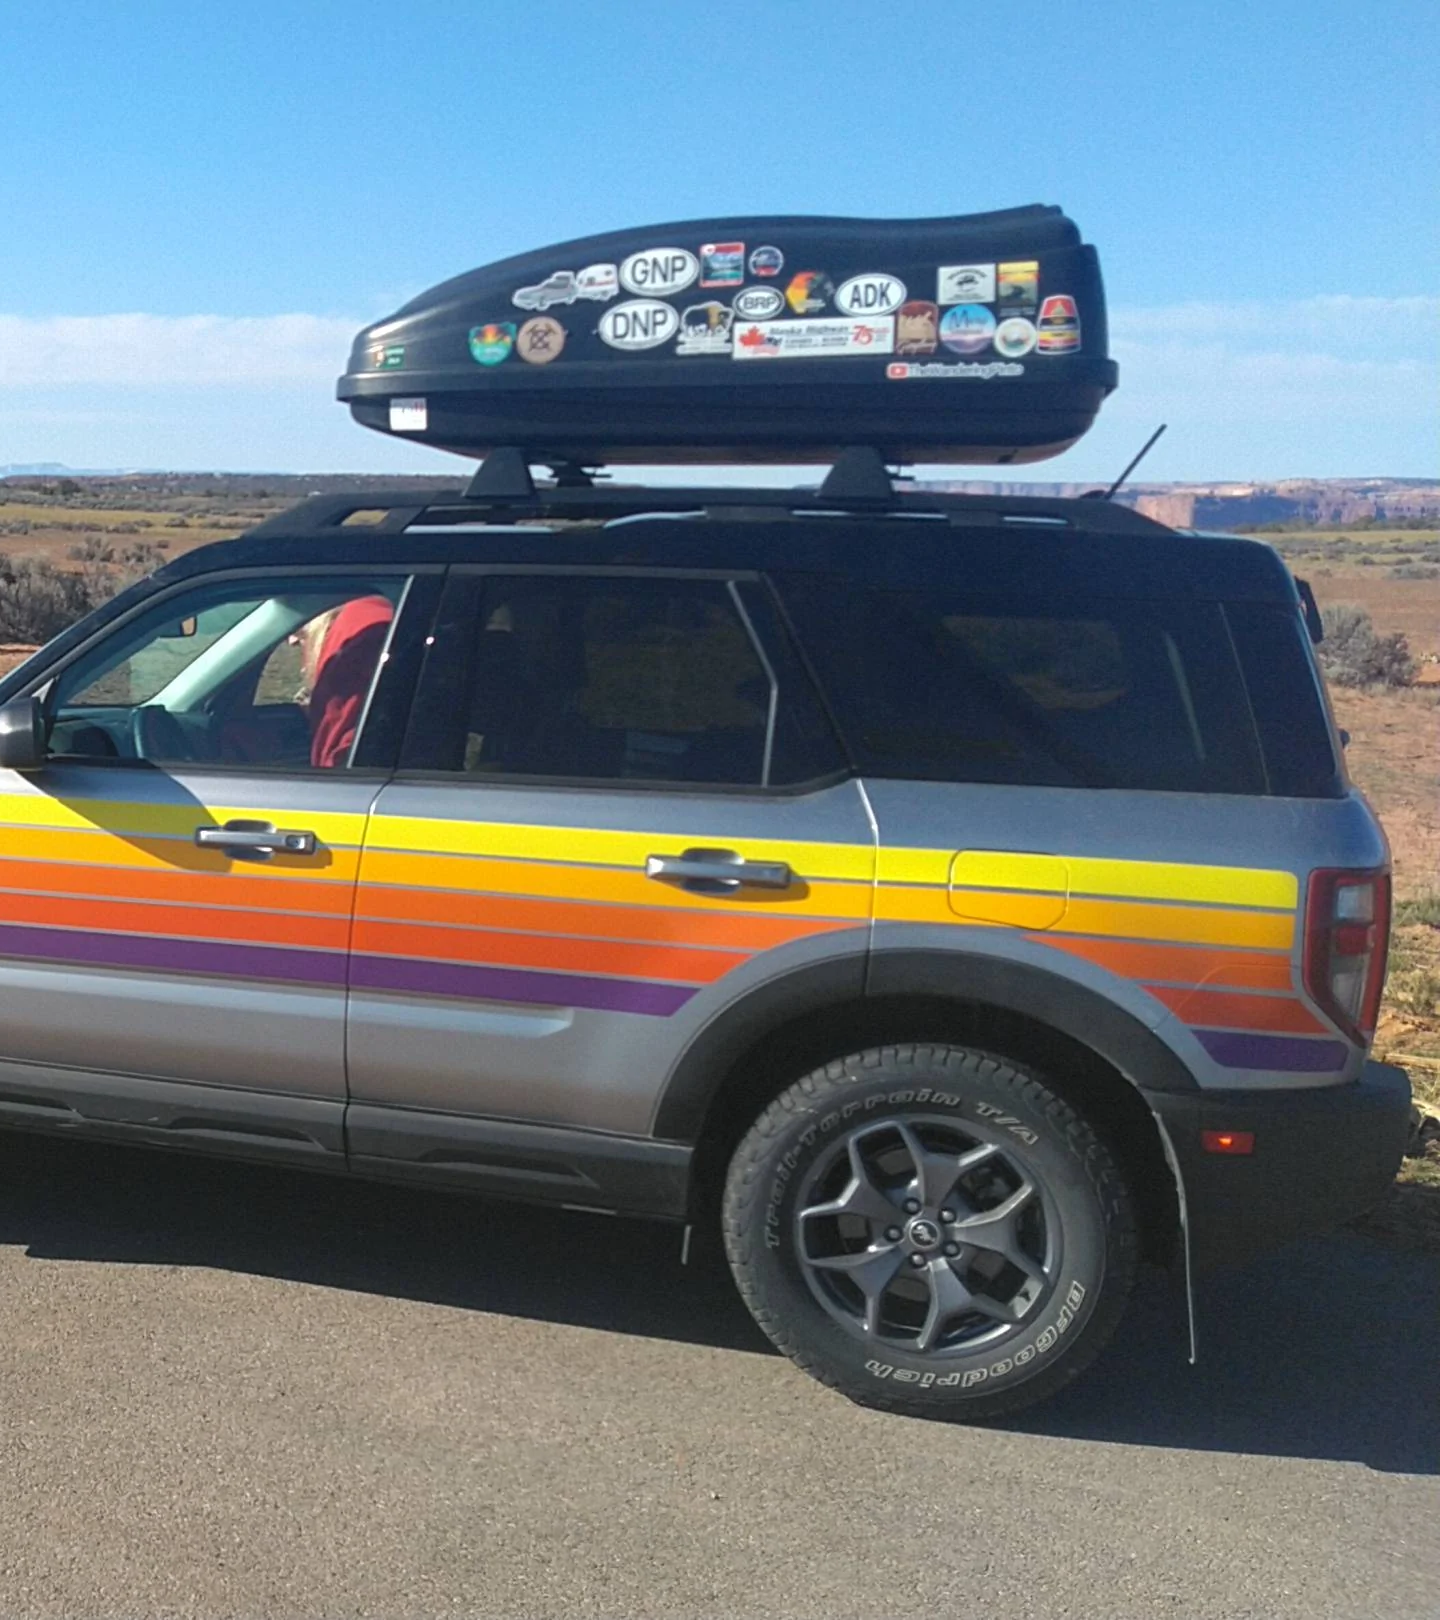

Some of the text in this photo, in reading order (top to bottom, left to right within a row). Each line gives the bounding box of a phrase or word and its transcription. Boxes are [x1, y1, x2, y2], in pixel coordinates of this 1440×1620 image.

[630, 254, 687, 285] GNP
[849, 281, 892, 309] ADK
[612, 308, 669, 339] DNP
[764, 1088, 1040, 1249] Trail-Terrain T/A
[864, 1280, 1086, 1388] BFGoodrich
